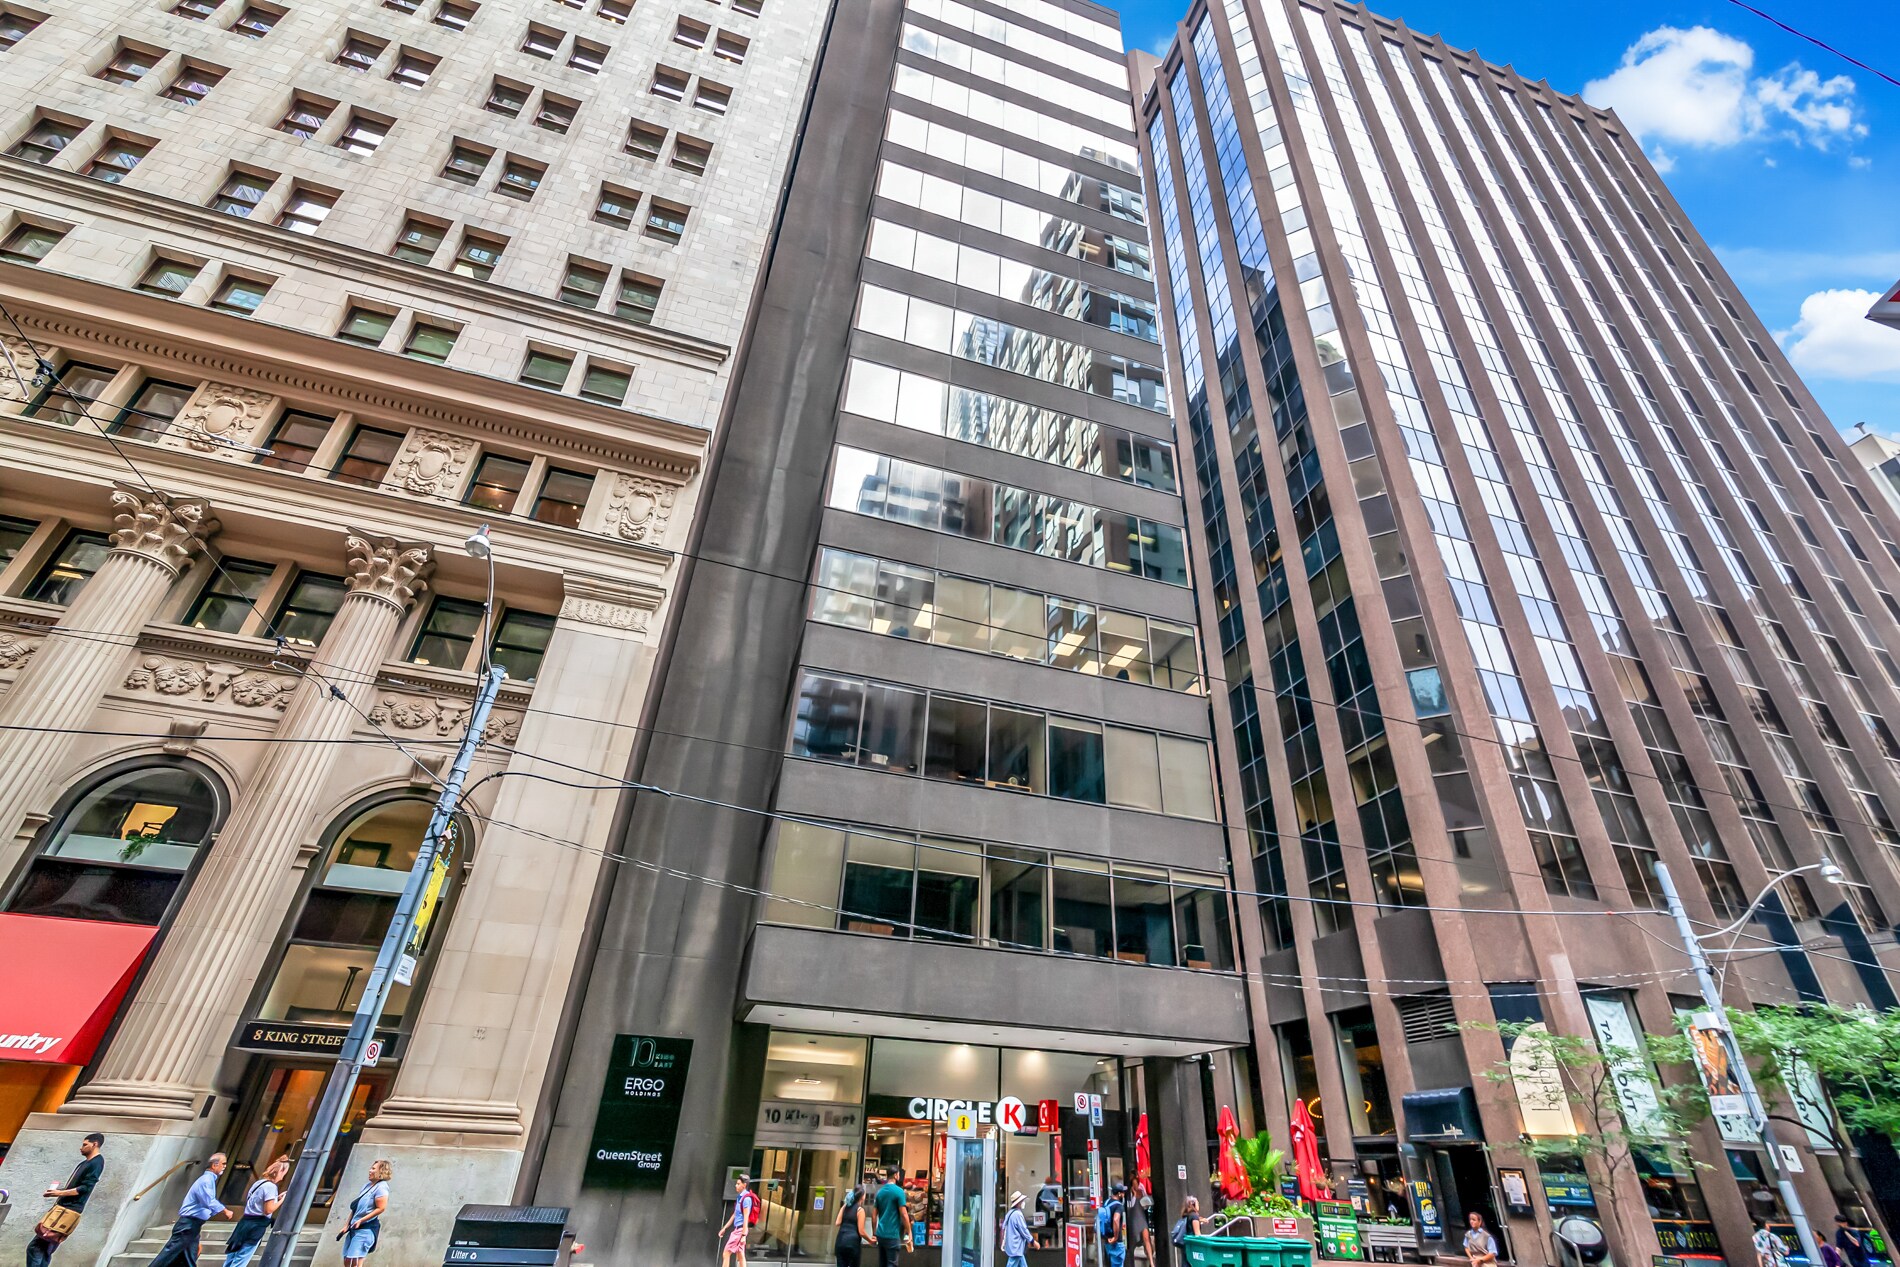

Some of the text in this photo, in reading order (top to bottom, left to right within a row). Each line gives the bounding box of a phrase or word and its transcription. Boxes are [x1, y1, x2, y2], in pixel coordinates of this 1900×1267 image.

[253, 1029, 263, 1041] 8
[264, 1031, 299, 1043] KING
[630, 1037, 657, 1067] 10
[624, 1077, 665, 1091] ERGO
[625, 1090, 661, 1098] HOLDINGS
[1617, 1072, 1638, 1113] OUT
[765, 1108, 781, 1124] 10
[1004, 1103, 1023, 1130] K
[596, 1149, 662, 1161] QueenStreet
[637, 1160, 661, 1170] Group
[451, 1249, 469, 1260] Litter
